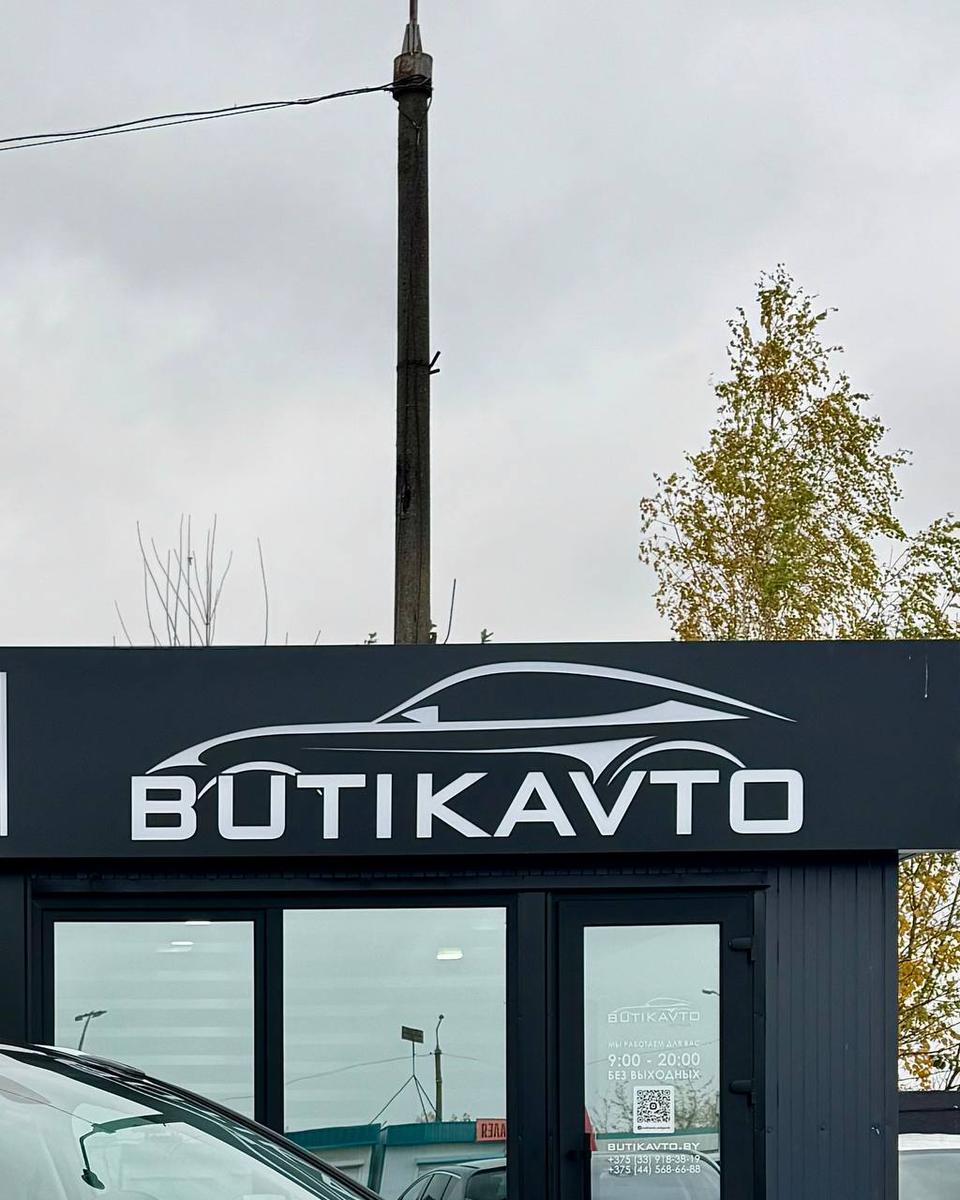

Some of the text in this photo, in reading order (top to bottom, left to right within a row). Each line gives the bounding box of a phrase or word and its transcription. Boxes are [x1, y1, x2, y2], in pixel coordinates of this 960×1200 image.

[131, 769, 804, 841] BUTIKAVTO
[607, 1011, 700, 1023] BUTIKAVTO
[608, 1053, 641, 1067] 9:00
[658, 1052, 701, 1066] 20:00
[608, 1069, 701, 1080] БЕЗ ВЫХОДНЫХ
[607, 1142, 700, 1151] BUTIKAVTO.BY
[608, 1154, 631, 1164] +375
[634, 1153, 652, 1166] (33)
[608, 1163, 701, 1176] +375 (44) 568-66-88
